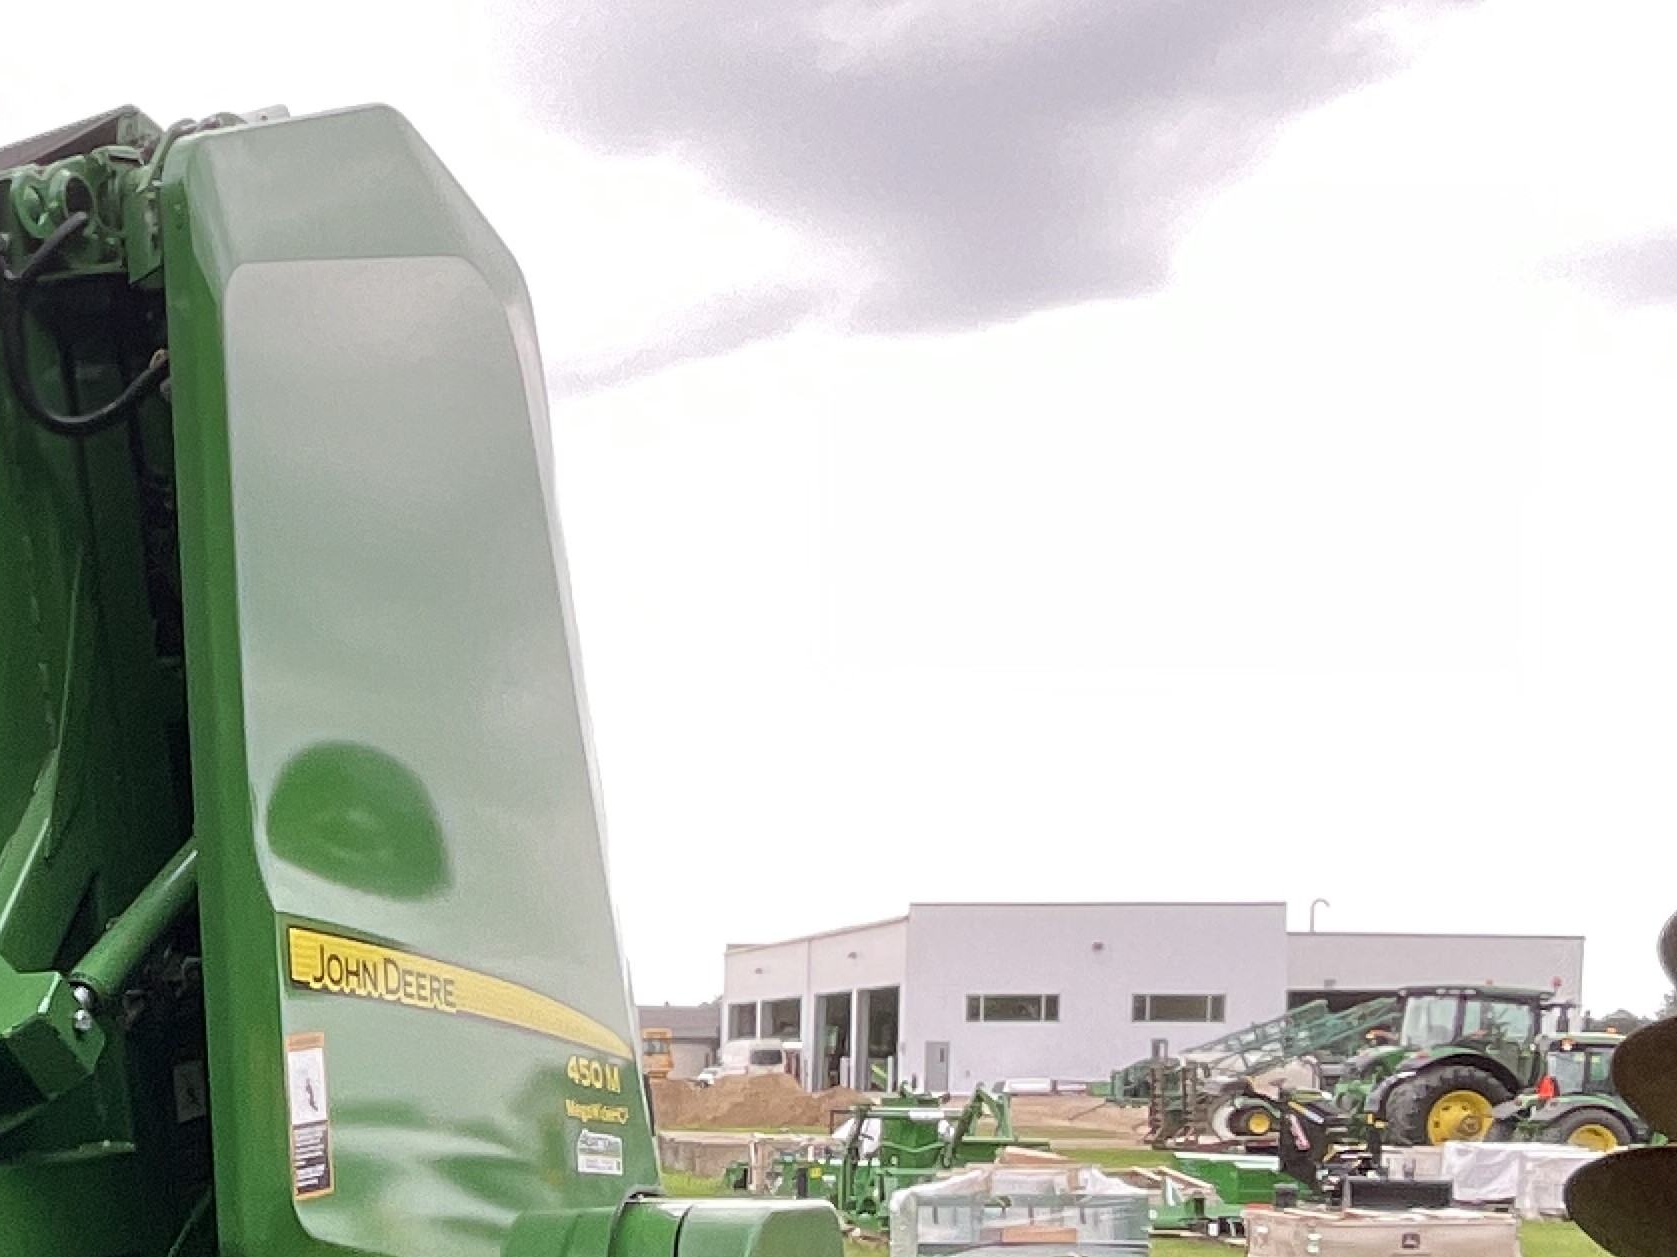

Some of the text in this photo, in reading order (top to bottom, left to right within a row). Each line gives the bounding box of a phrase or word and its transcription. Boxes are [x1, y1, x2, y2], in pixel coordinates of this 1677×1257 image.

[311, 943, 457, 1008] JOHN DEERE
[567, 1055, 603, 1089] 450
